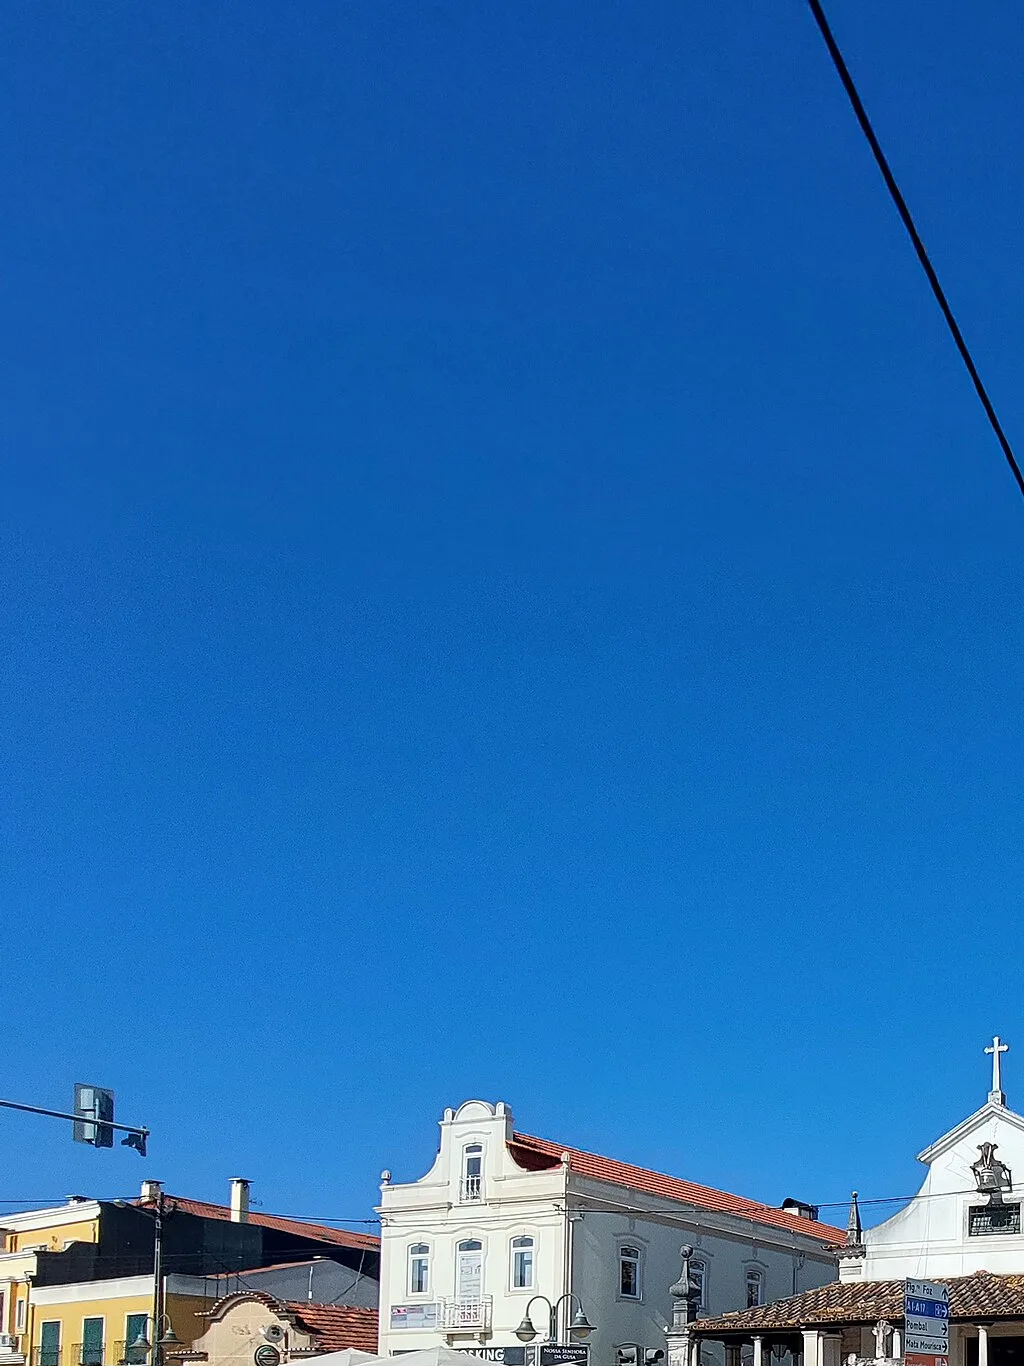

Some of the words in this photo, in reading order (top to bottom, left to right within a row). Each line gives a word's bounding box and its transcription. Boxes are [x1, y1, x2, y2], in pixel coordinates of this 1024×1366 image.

[922, 1284, 933, 1295] Foz
[906, 1320, 928, 1331] Pombal
[906, 1338, 919, 1349] Mata
[920, 1340, 942, 1350] Mourisca
